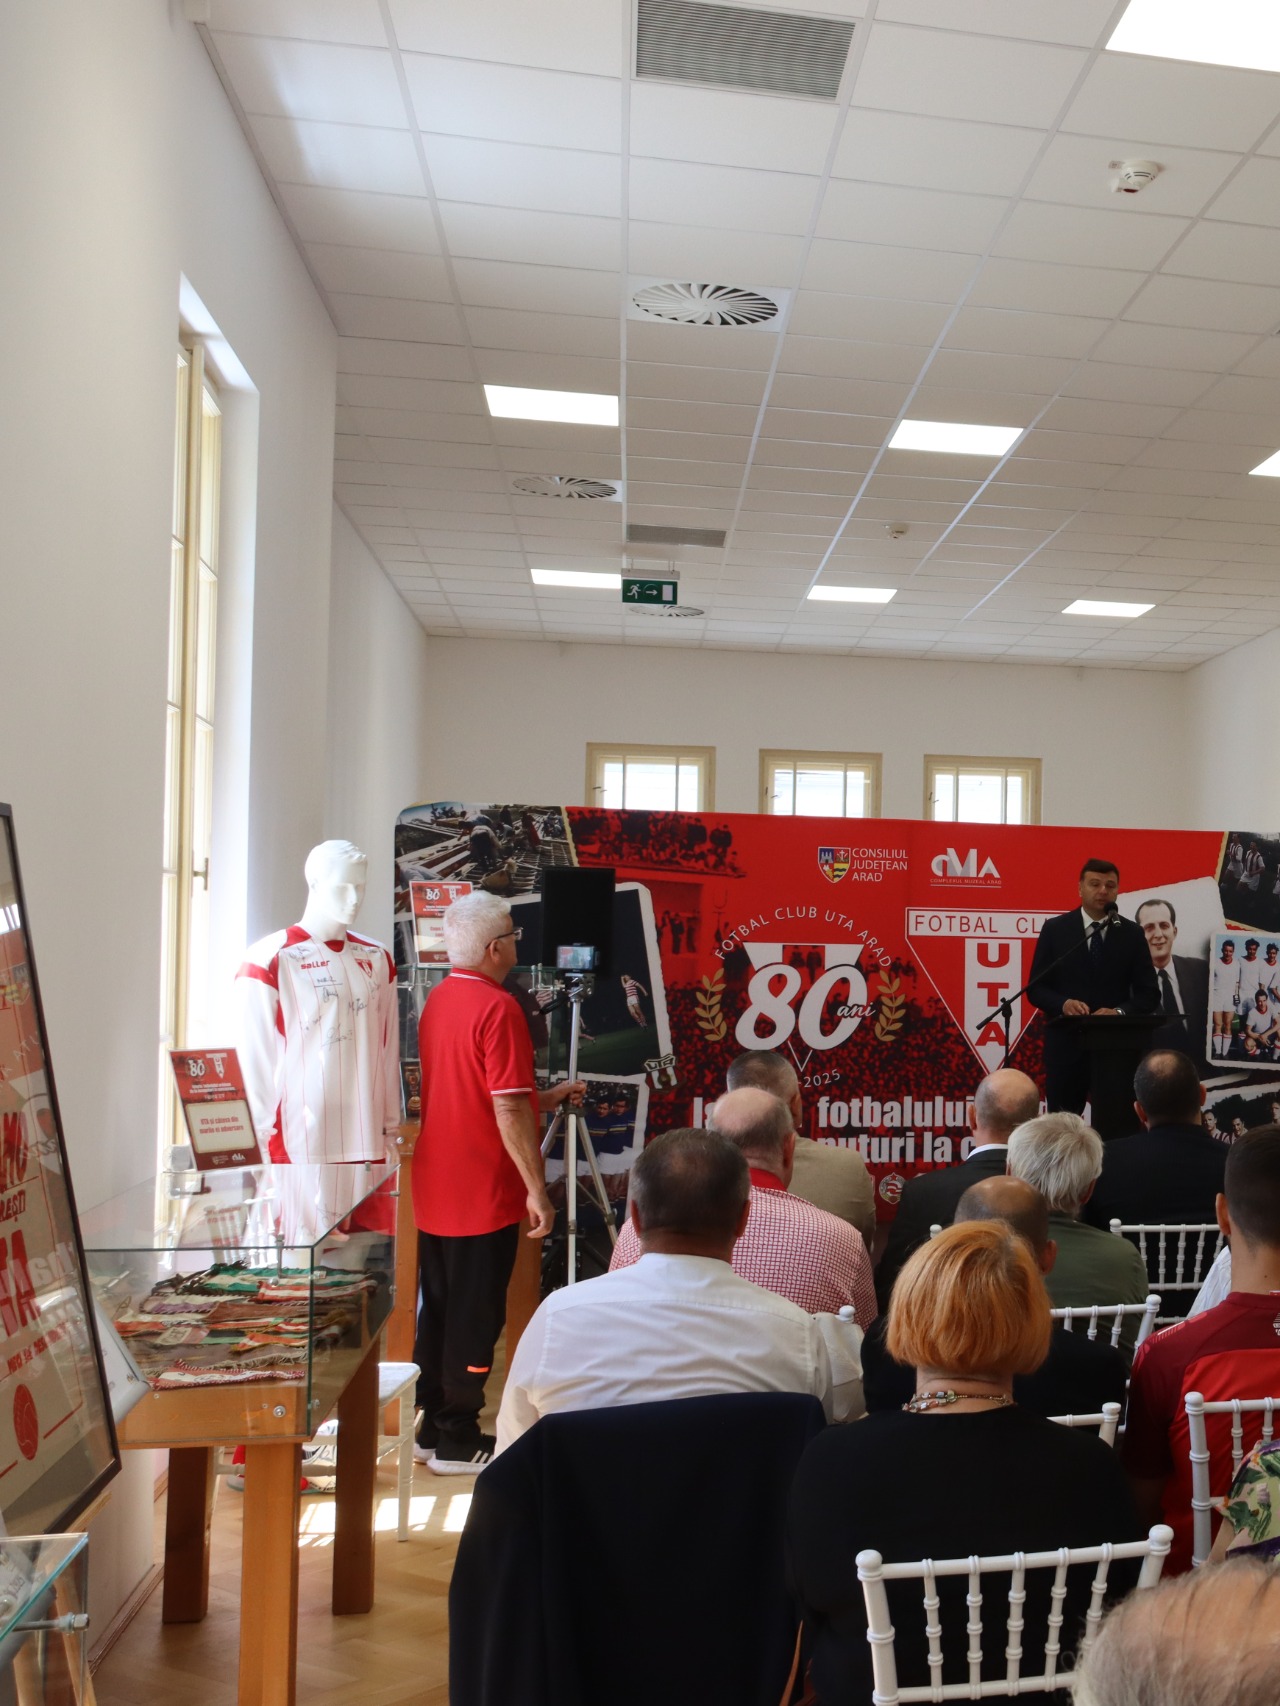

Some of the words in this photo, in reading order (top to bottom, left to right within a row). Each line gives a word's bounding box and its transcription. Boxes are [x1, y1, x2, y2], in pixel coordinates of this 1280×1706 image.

[852, 848, 908, 859] CONSILIUL
[852, 872, 882, 882] ARAD
[914, 915, 998, 933] FOTBAL
[1016, 917, 1048, 934] CL
[714, 914, 770, 960] FOTBAL
[774, 906, 817, 920] CLUB
[825, 910, 854, 931] UTA
[857, 930, 892, 968] ARAD
[301, 960, 330, 970] saller
[975, 942, 1010, 1047] UTA
[735, 962, 868, 1051] 80
[836, 1002, 876, 1018] ani
[804, 1069, 841, 1089] 2025
[817, 1095, 975, 1128] fotbalului
[923, 1131, 952, 1163] la
